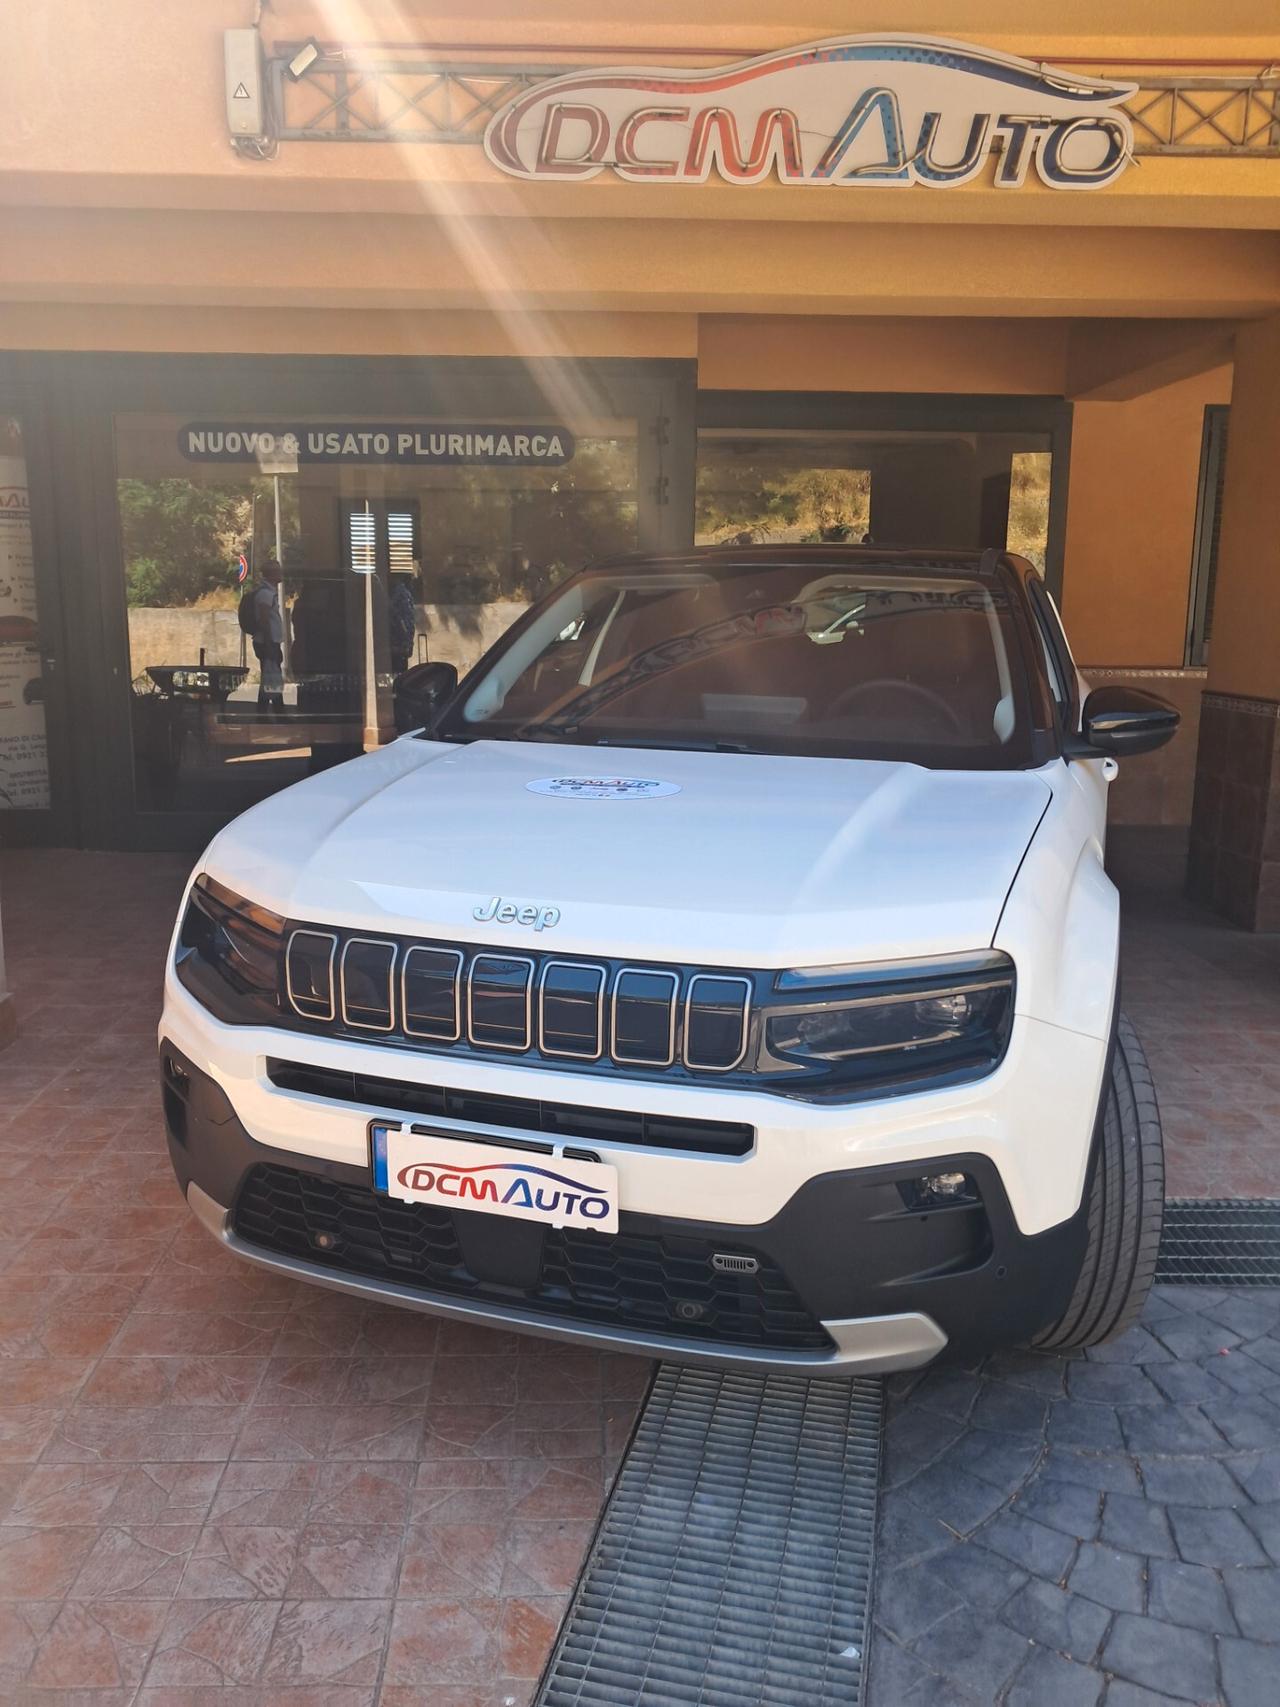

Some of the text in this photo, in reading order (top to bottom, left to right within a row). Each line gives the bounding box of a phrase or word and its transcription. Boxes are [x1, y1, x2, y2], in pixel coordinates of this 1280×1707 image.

[188, 431, 565, 457] NUOVO & USATO PLURIMARCA
[473, 896, 560, 932] Jeep
